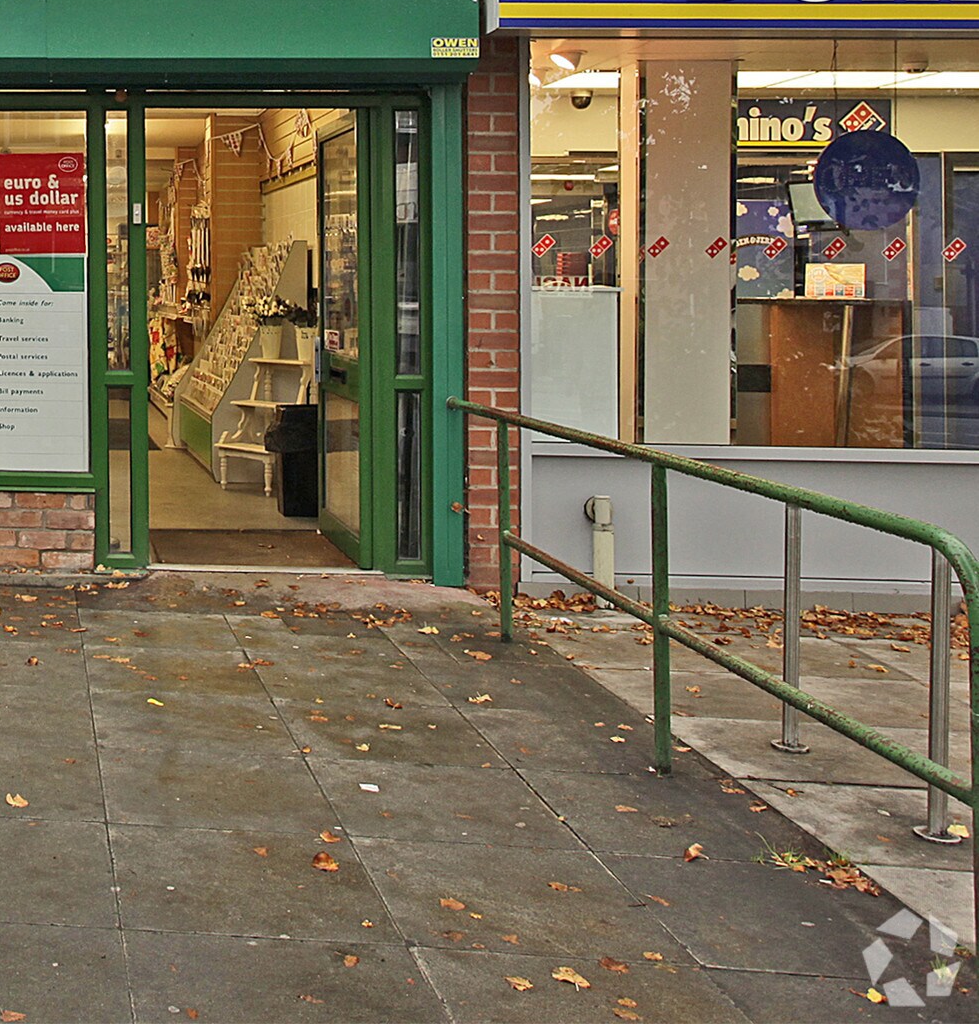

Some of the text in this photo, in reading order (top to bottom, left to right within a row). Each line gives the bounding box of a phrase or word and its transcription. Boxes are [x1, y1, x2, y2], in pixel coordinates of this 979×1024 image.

[433, 38, 478, 47] OWEN
[4, 174, 59, 189] euro &
[4, 190, 79, 205] us dollar
[5, 222, 80, 232] available here
[11, 388, 44, 396] payments
